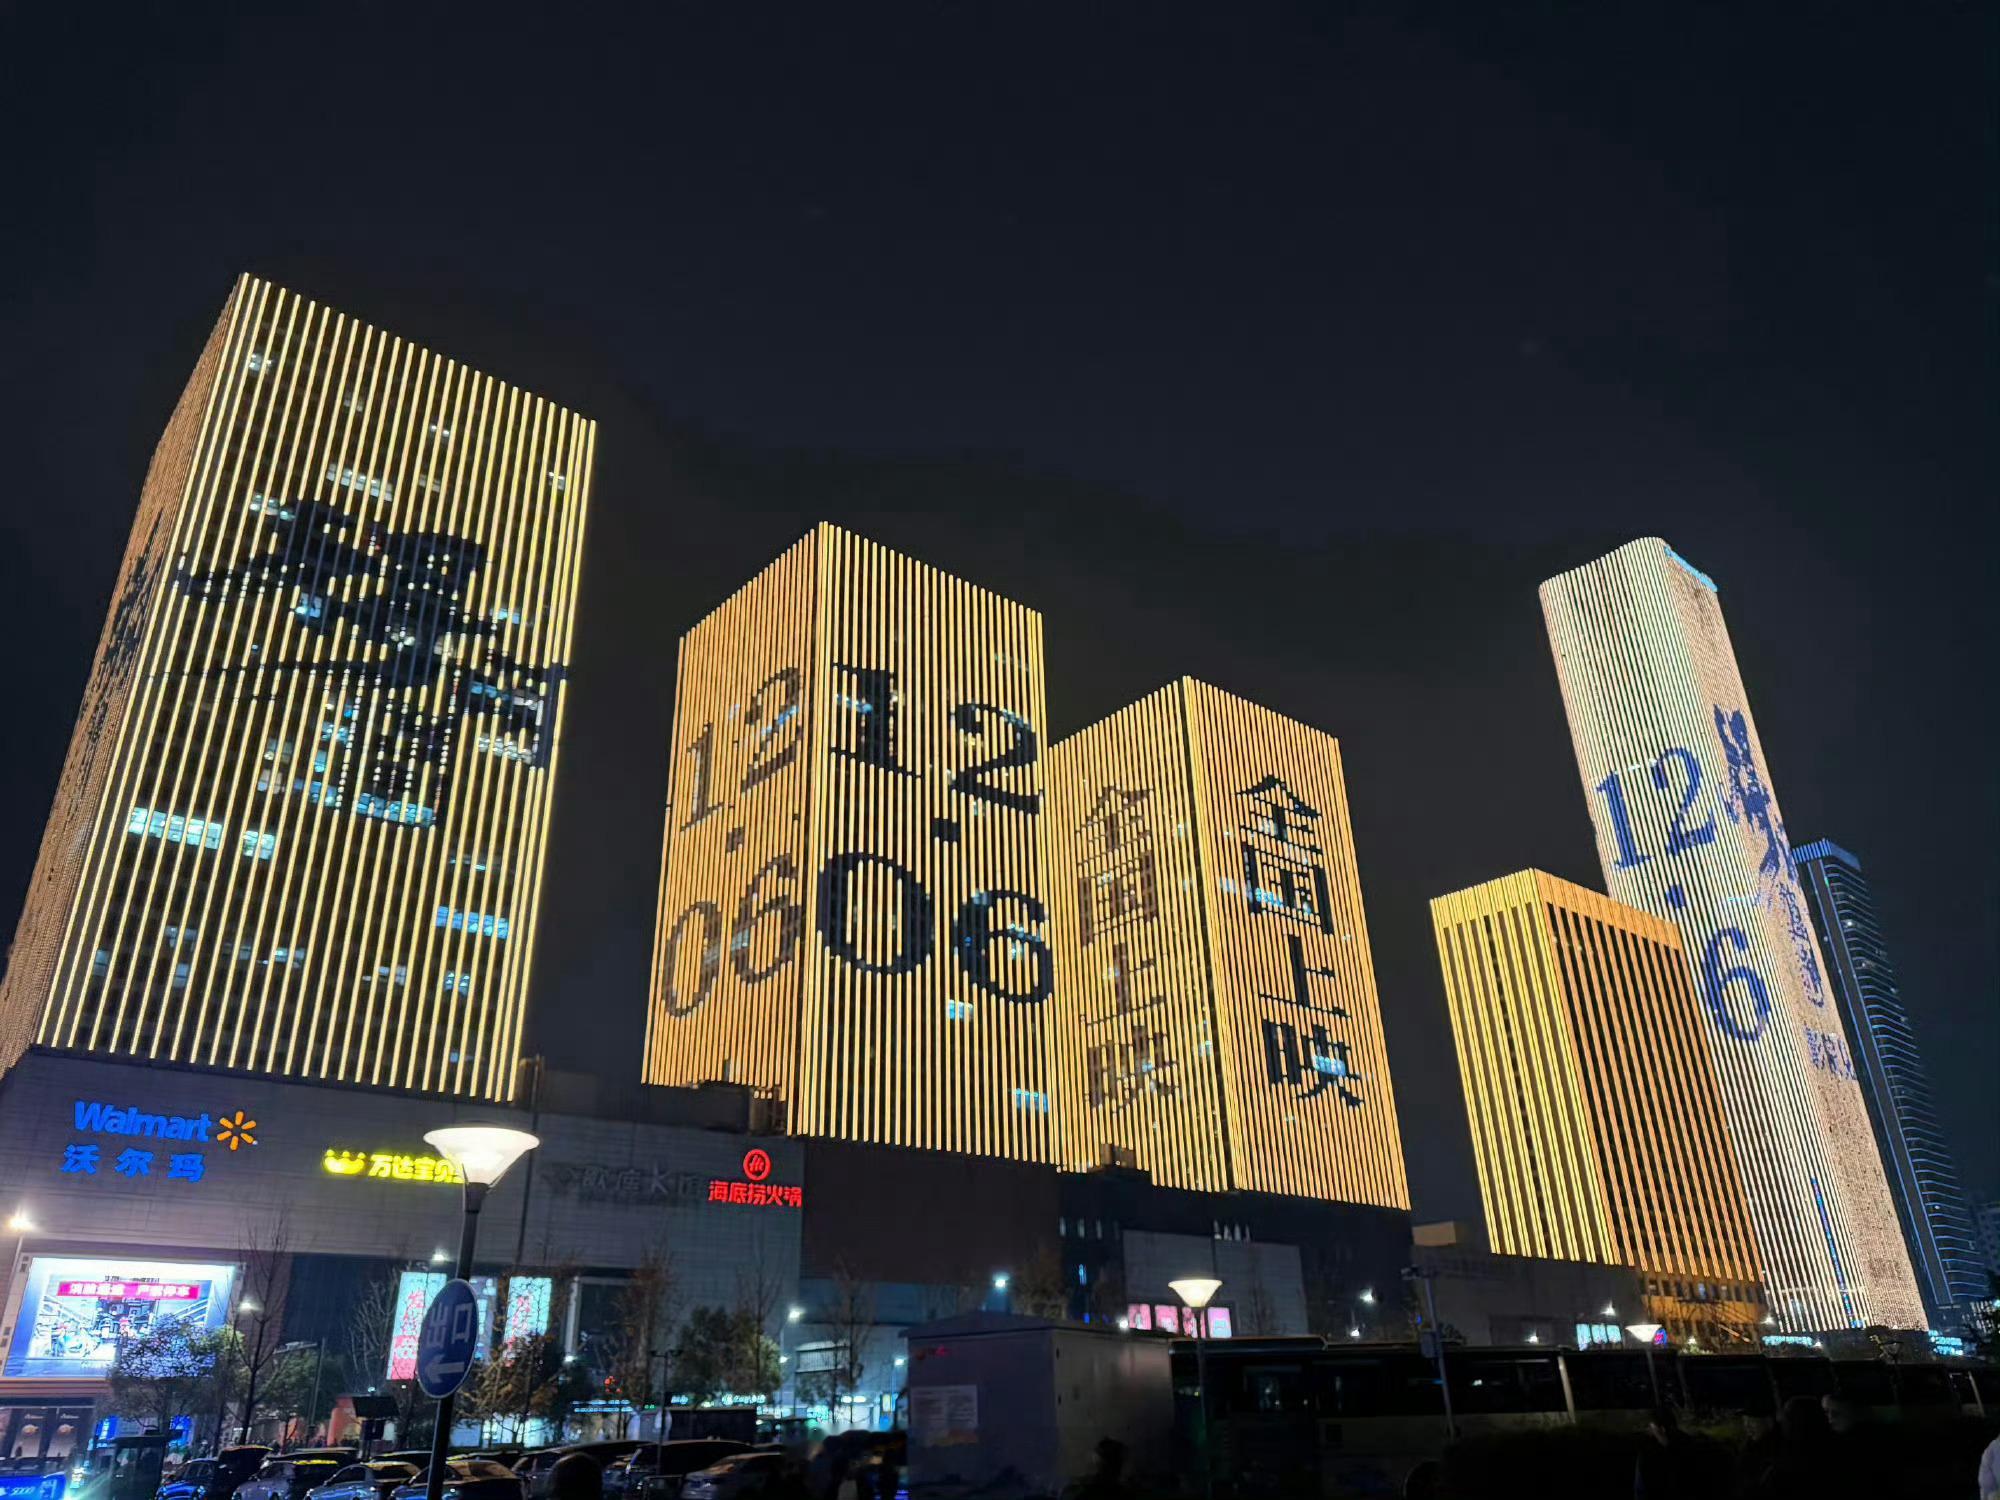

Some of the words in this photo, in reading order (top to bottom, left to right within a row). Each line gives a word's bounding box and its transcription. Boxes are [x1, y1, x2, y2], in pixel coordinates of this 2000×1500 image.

[74, 1101, 211, 1142] Walmart
[60, 1144, 206, 1183] 沃尔玛
[708, 1180, 803, 1208] 海底捞火锅
[426, 1302, 474, 1348] 出口
